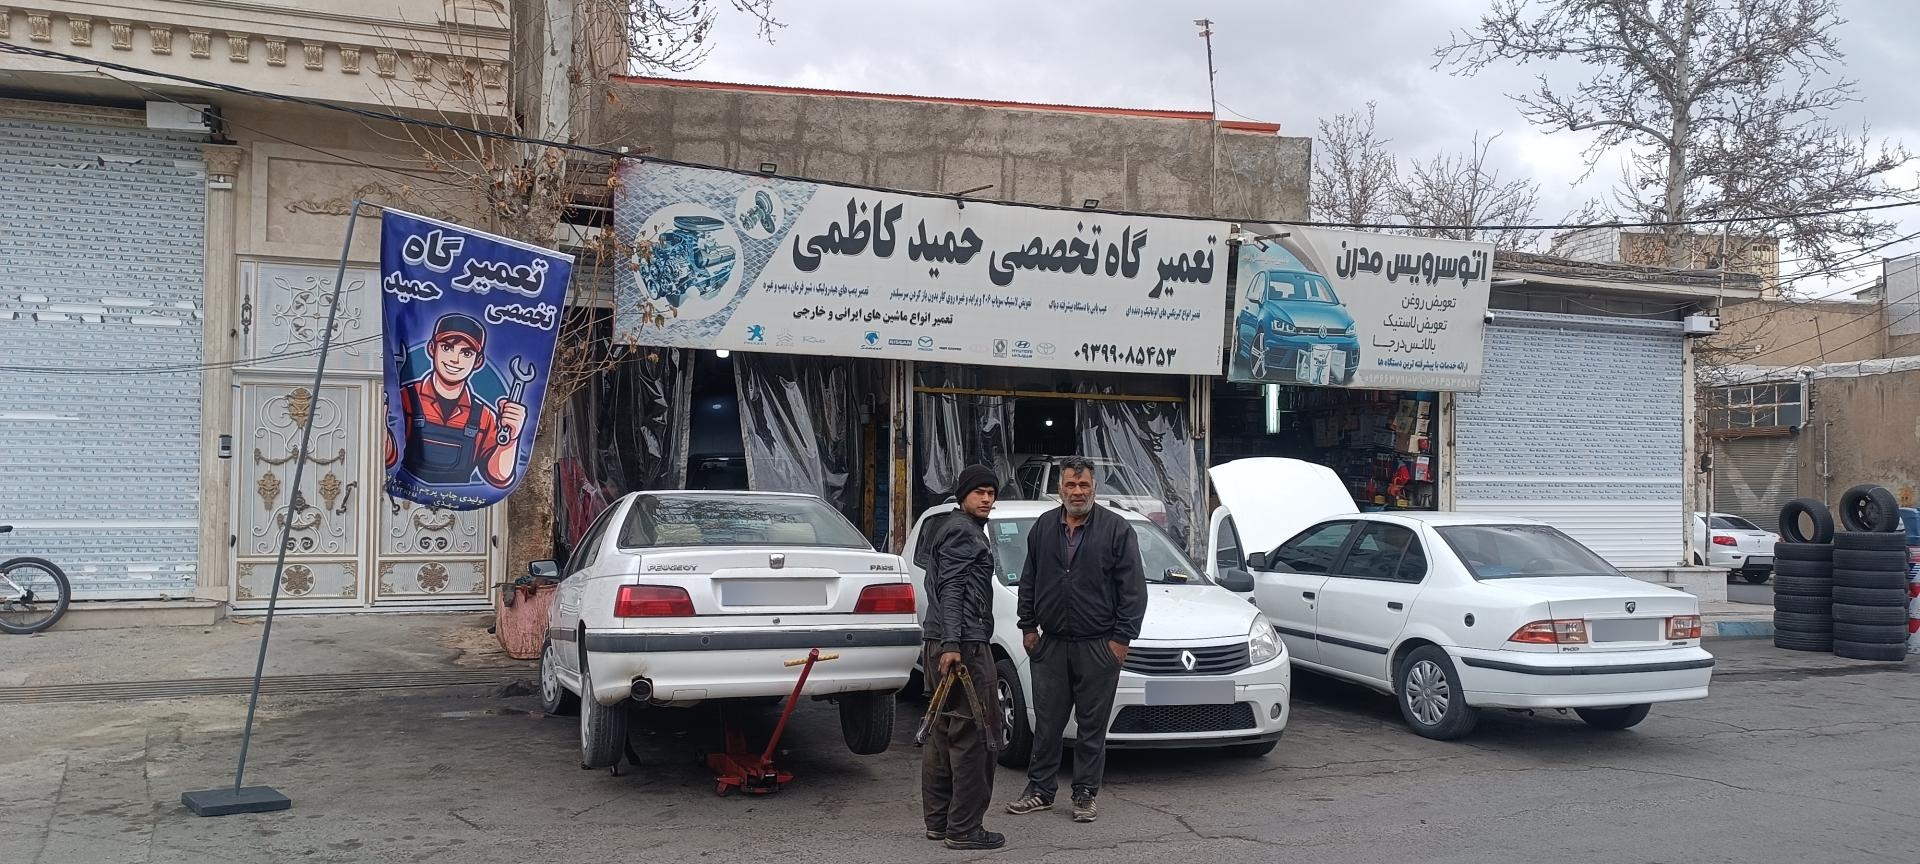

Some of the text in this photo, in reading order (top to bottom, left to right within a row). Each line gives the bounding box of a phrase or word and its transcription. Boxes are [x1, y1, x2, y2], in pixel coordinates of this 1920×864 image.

[792, 196, 1217, 299] تعمیر گاه تخصصی حمید کاظمی
[402, 230, 549, 297] تعمیر گاه
[1336, 240, 1488, 287] اتوسرویس مدرن
[384, 271, 557, 330] تخصصی حمید
[1401, 295, 1457, 313] تعویض روغن
[793, 305, 953, 327] تعمیر انواع ماشین های ایرانی و خارجی
[1384, 313, 1448, 335] تعویض لاستیک
[1074, 343, 1177, 367] ۰۹۳۹۹۰۸۵۴۵۳
[1440, 359, 1456, 370] خدمات
[440, 491, 457, 501] چاپ
[647, 564, 698, 572] PEUGEOT
